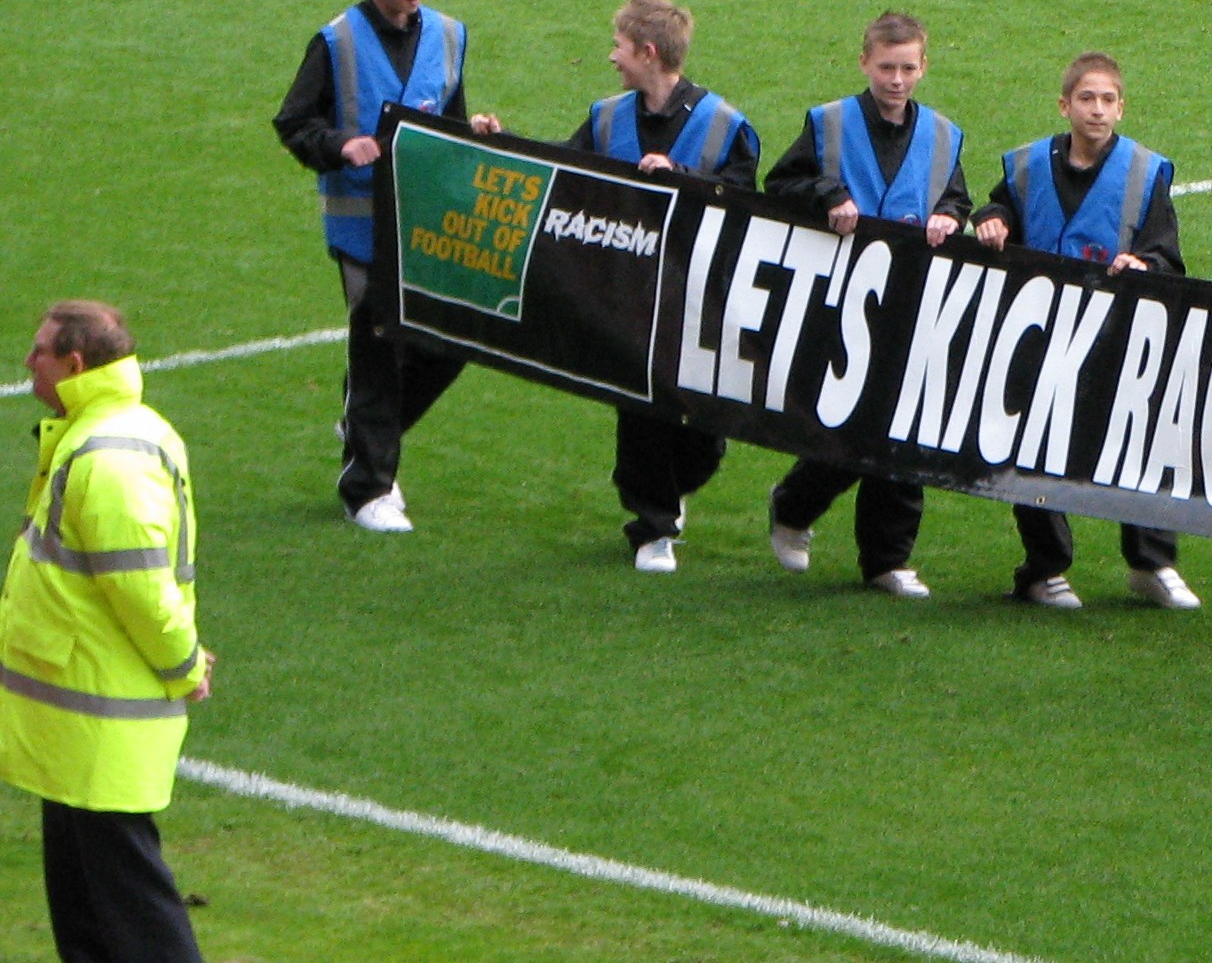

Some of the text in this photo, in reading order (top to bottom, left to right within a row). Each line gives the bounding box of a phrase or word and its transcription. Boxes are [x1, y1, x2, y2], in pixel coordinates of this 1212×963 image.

[473, 165, 544, 201] LET'S
[442, 210, 527, 253] OUT OF
[473, 193, 533, 227] KICK
[544, 208, 660, 257] RACISM
[410, 227, 517, 281] FOOTBALL
[678, 205, 893, 429] LET'S
[888, 255, 1116, 476] KICK
